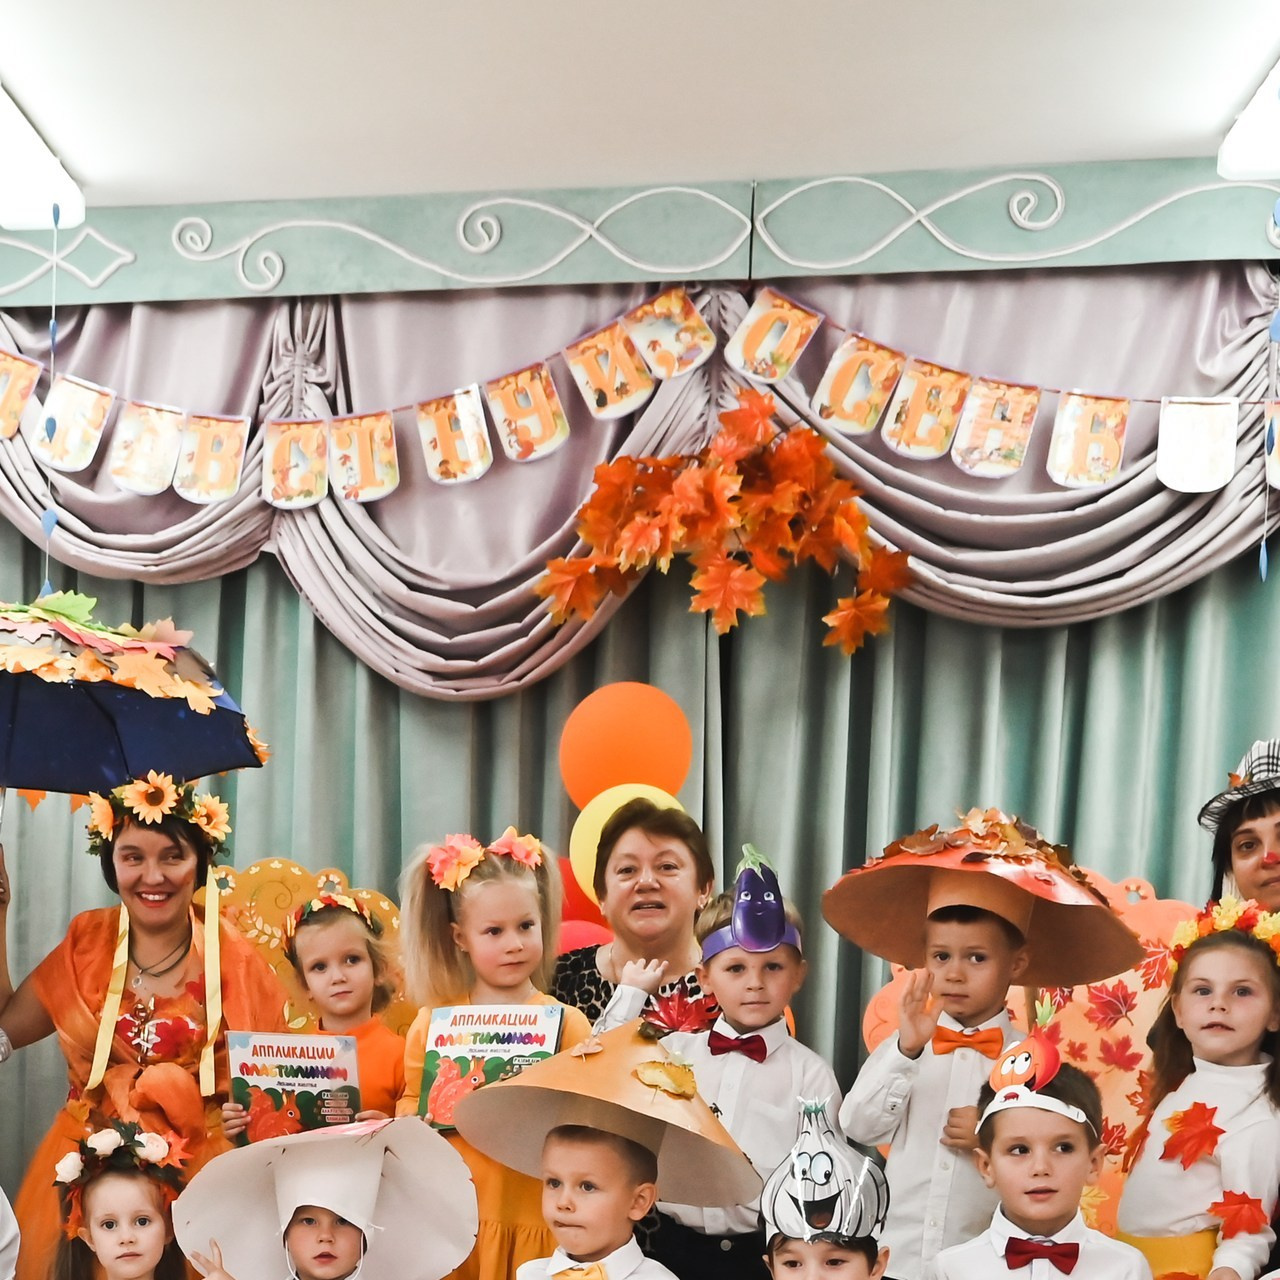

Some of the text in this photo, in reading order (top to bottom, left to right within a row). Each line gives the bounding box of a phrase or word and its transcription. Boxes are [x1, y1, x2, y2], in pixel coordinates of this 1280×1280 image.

[450, 1013, 538, 1028] АППЛИКАЦИИ
[435, 1031, 546, 1047] ПЛАСТИЛИНОМ
[252, 1044, 335, 1060] АППЛИКАЦИИ
[239, 1062, 348, 1081] ПЛАСТИЛИНОМ
